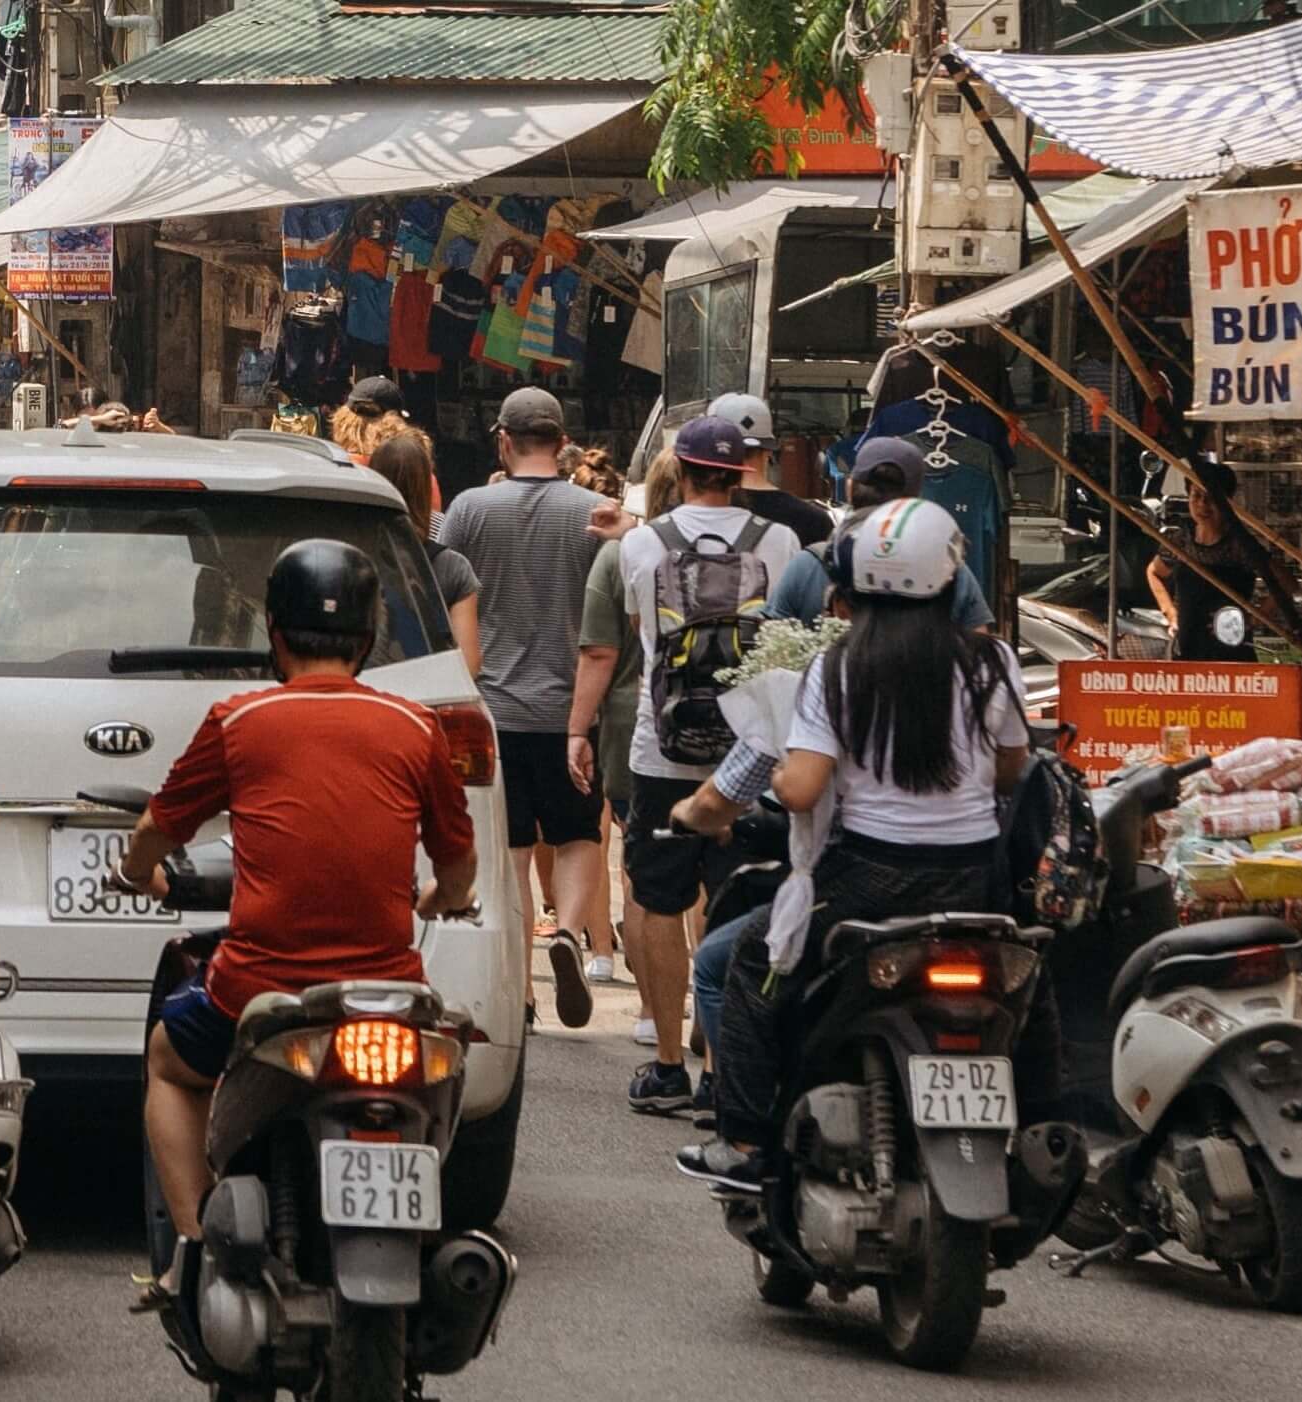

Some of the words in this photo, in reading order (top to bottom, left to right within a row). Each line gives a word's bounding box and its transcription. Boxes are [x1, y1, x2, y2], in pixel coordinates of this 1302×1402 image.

[1209, 357, 1291, 405] BÚN
[1081, 670, 1127, 691] UBND
[1132, 670, 1178, 695] QUẬN
[1184, 671, 1231, 693] HOÀN
[1235, 670, 1279, 694] KIẾM
[1104, 704, 1160, 728] TUYẾN
[1165, 703, 1199, 728] PHỐ
[1206, 704, 1246, 729] CẤM
[97, 730, 143, 750] KIA
[1094, 742, 1108, 757] XE
[81, 833, 134, 871] 30
[927, 1062, 998, 1090] 29-D2
[922, 1094, 1007, 1122] 211.27
[341, 1150, 421, 1185] 29-U4
[341, 1186, 422, 1220] 6218
